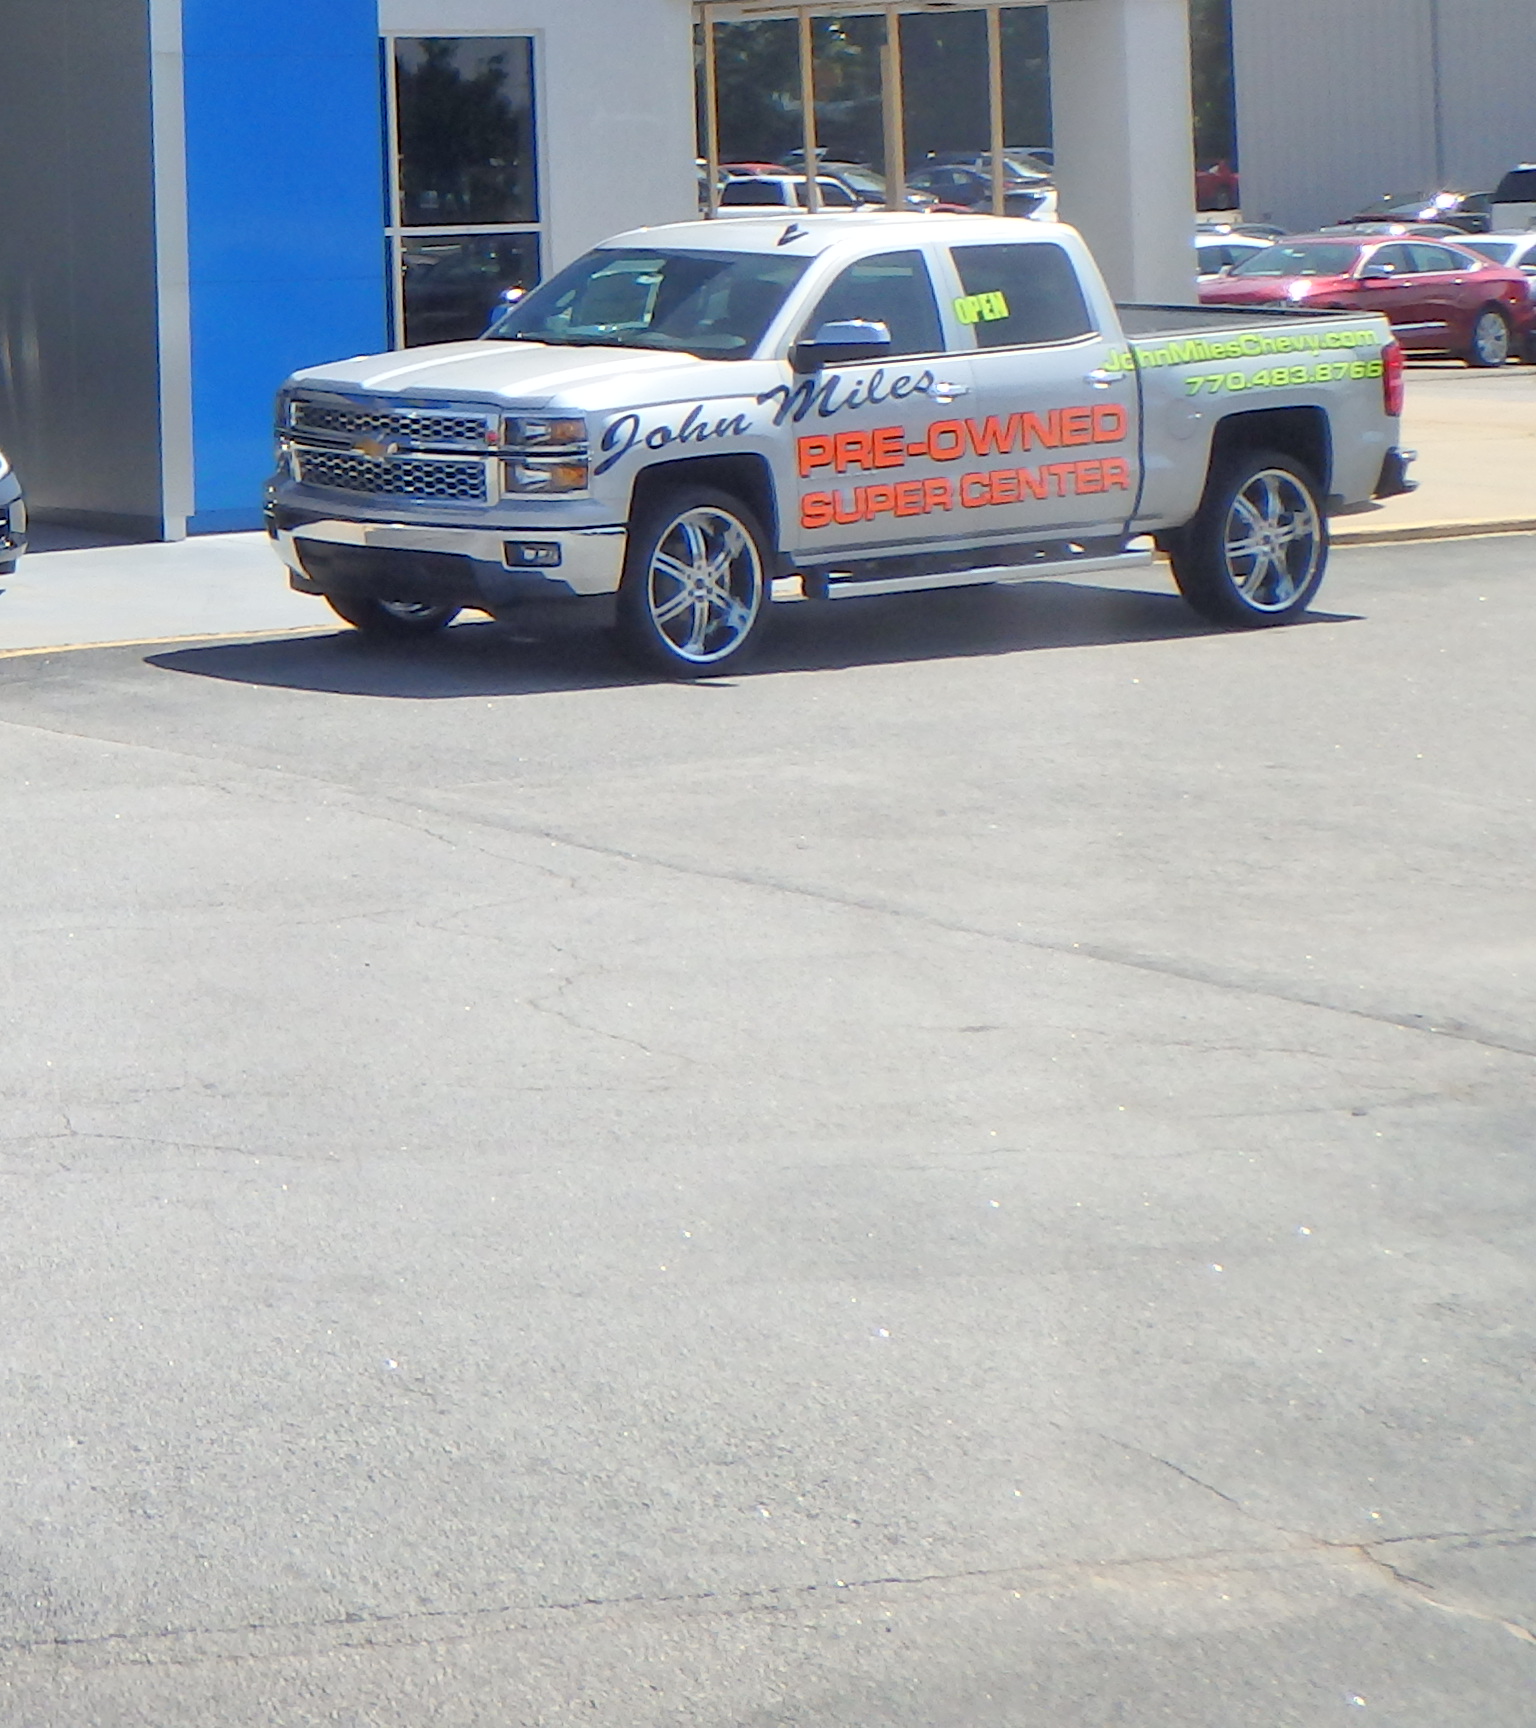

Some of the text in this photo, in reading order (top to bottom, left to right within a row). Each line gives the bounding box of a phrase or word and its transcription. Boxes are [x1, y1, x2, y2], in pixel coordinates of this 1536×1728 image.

[953, 290, 1009, 325] OPEN
[1102, 329, 1379, 372] JohnMilesChevy.com
[593, 368, 936, 476] John Miles
[796, 403, 1127, 478] PRE-OWNED
[800, 456, 1130, 530] SUPER CENTER
